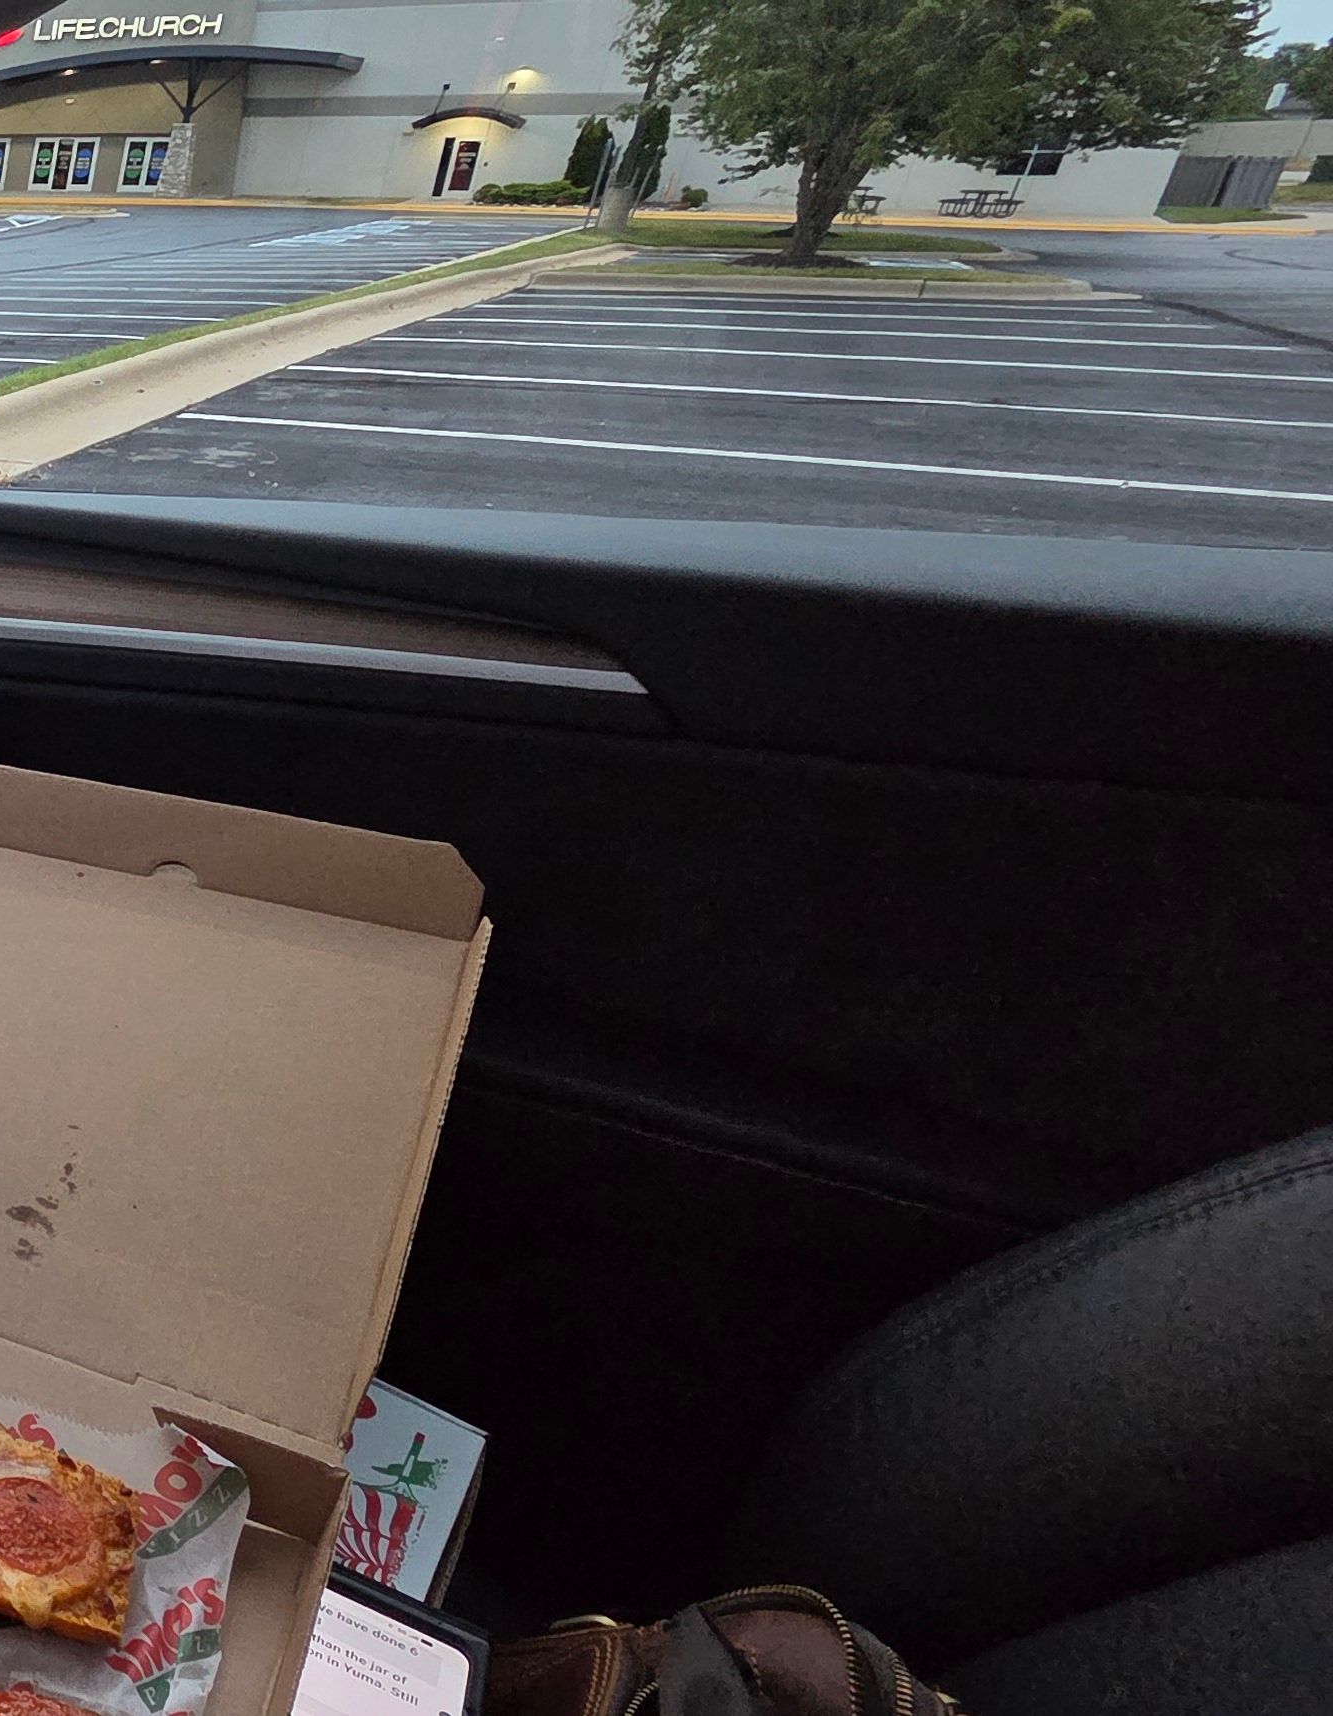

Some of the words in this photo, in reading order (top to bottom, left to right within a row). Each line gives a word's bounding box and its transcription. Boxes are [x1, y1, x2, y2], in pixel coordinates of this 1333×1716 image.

[33, 13, 223, 41] LIFE.CHURCH
[336, 1611, 369, 1633] have
[372, 1629, 407, 1651] done
[410, 1646, 419, 1657] 6
[312, 1633, 341, 1654] than
[344, 1649, 367, 1666] the
[367, 1659, 389, 1677] jar
[392, 1672, 408, 1686] of
[327, 1655, 340, 1668] in
[343, 1661, 386, 1692] Yuma.
[390, 1686, 420, 1707] Still
